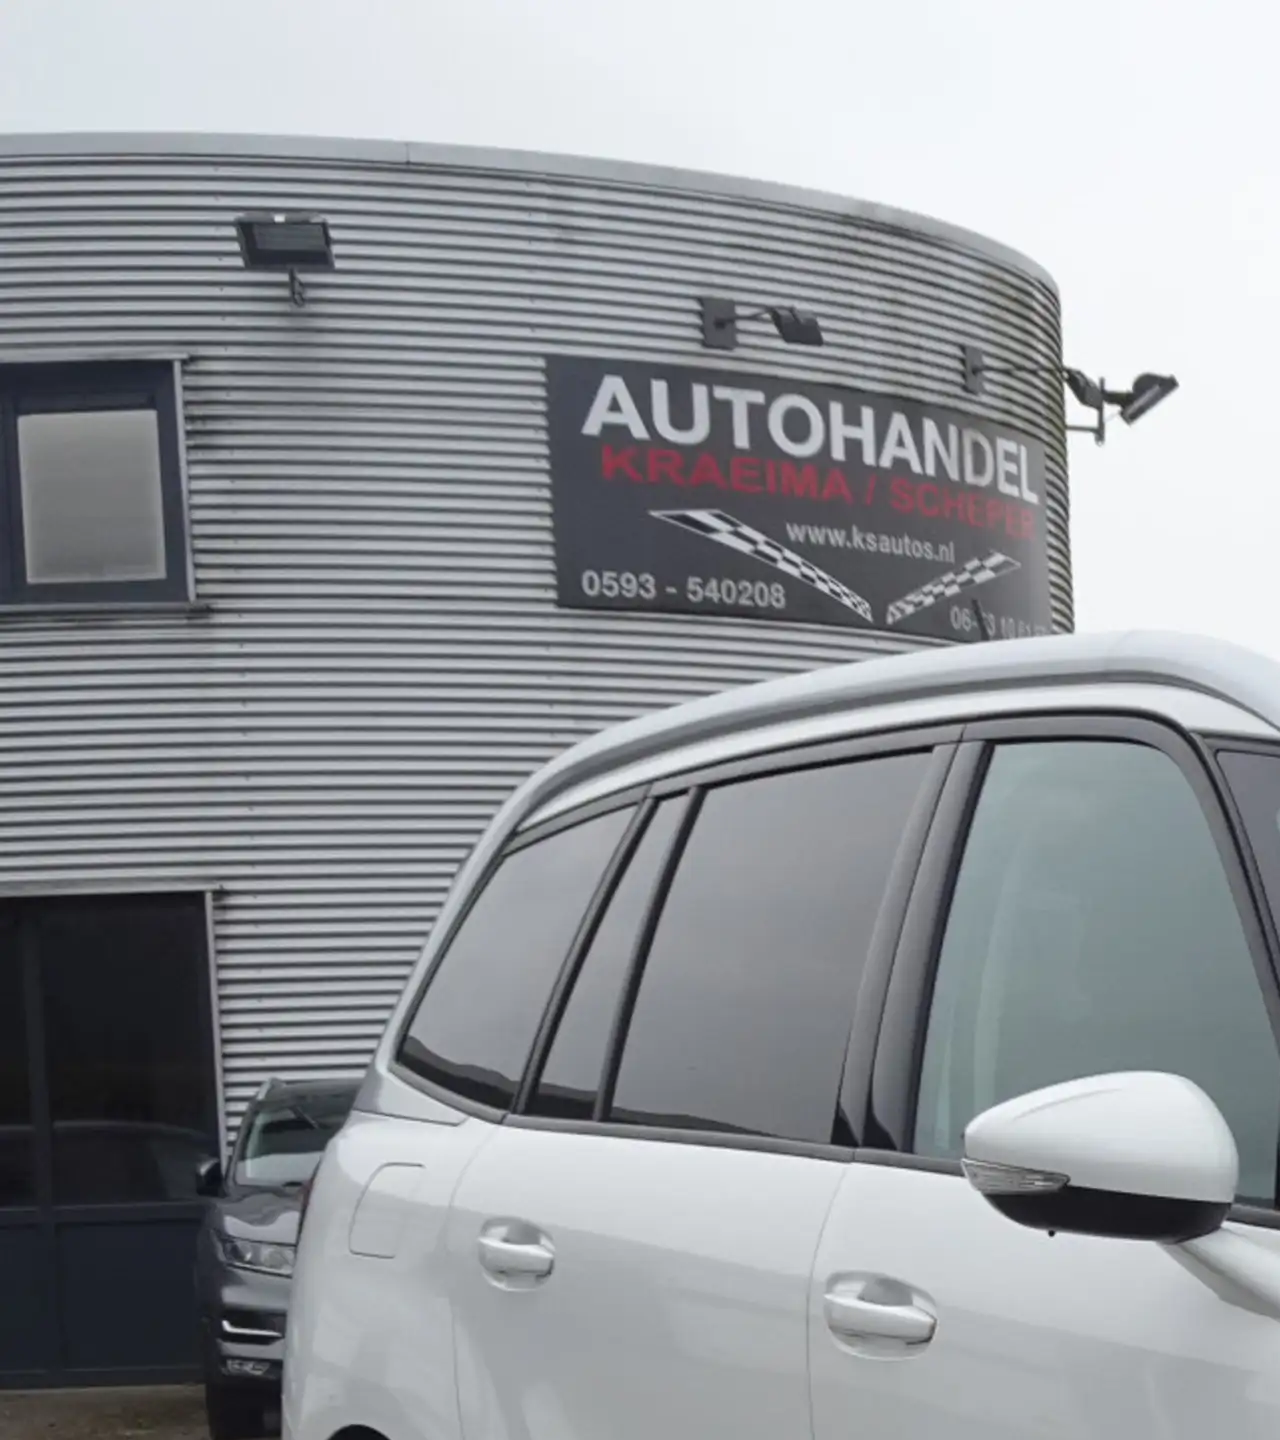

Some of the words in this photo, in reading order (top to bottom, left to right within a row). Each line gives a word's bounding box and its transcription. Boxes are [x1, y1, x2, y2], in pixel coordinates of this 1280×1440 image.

[581, 373, 1039, 505] AUTOHANDEL
[601, 444, 854, 505] KRAEIMA
[864, 476, 877, 507] /
[890, 476, 1037, 541] SCHEPER
[786, 522, 955, 564] www.ksautos.nl
[581, 571, 656, 600] 0593
[686, 576, 786, 609] 540208
